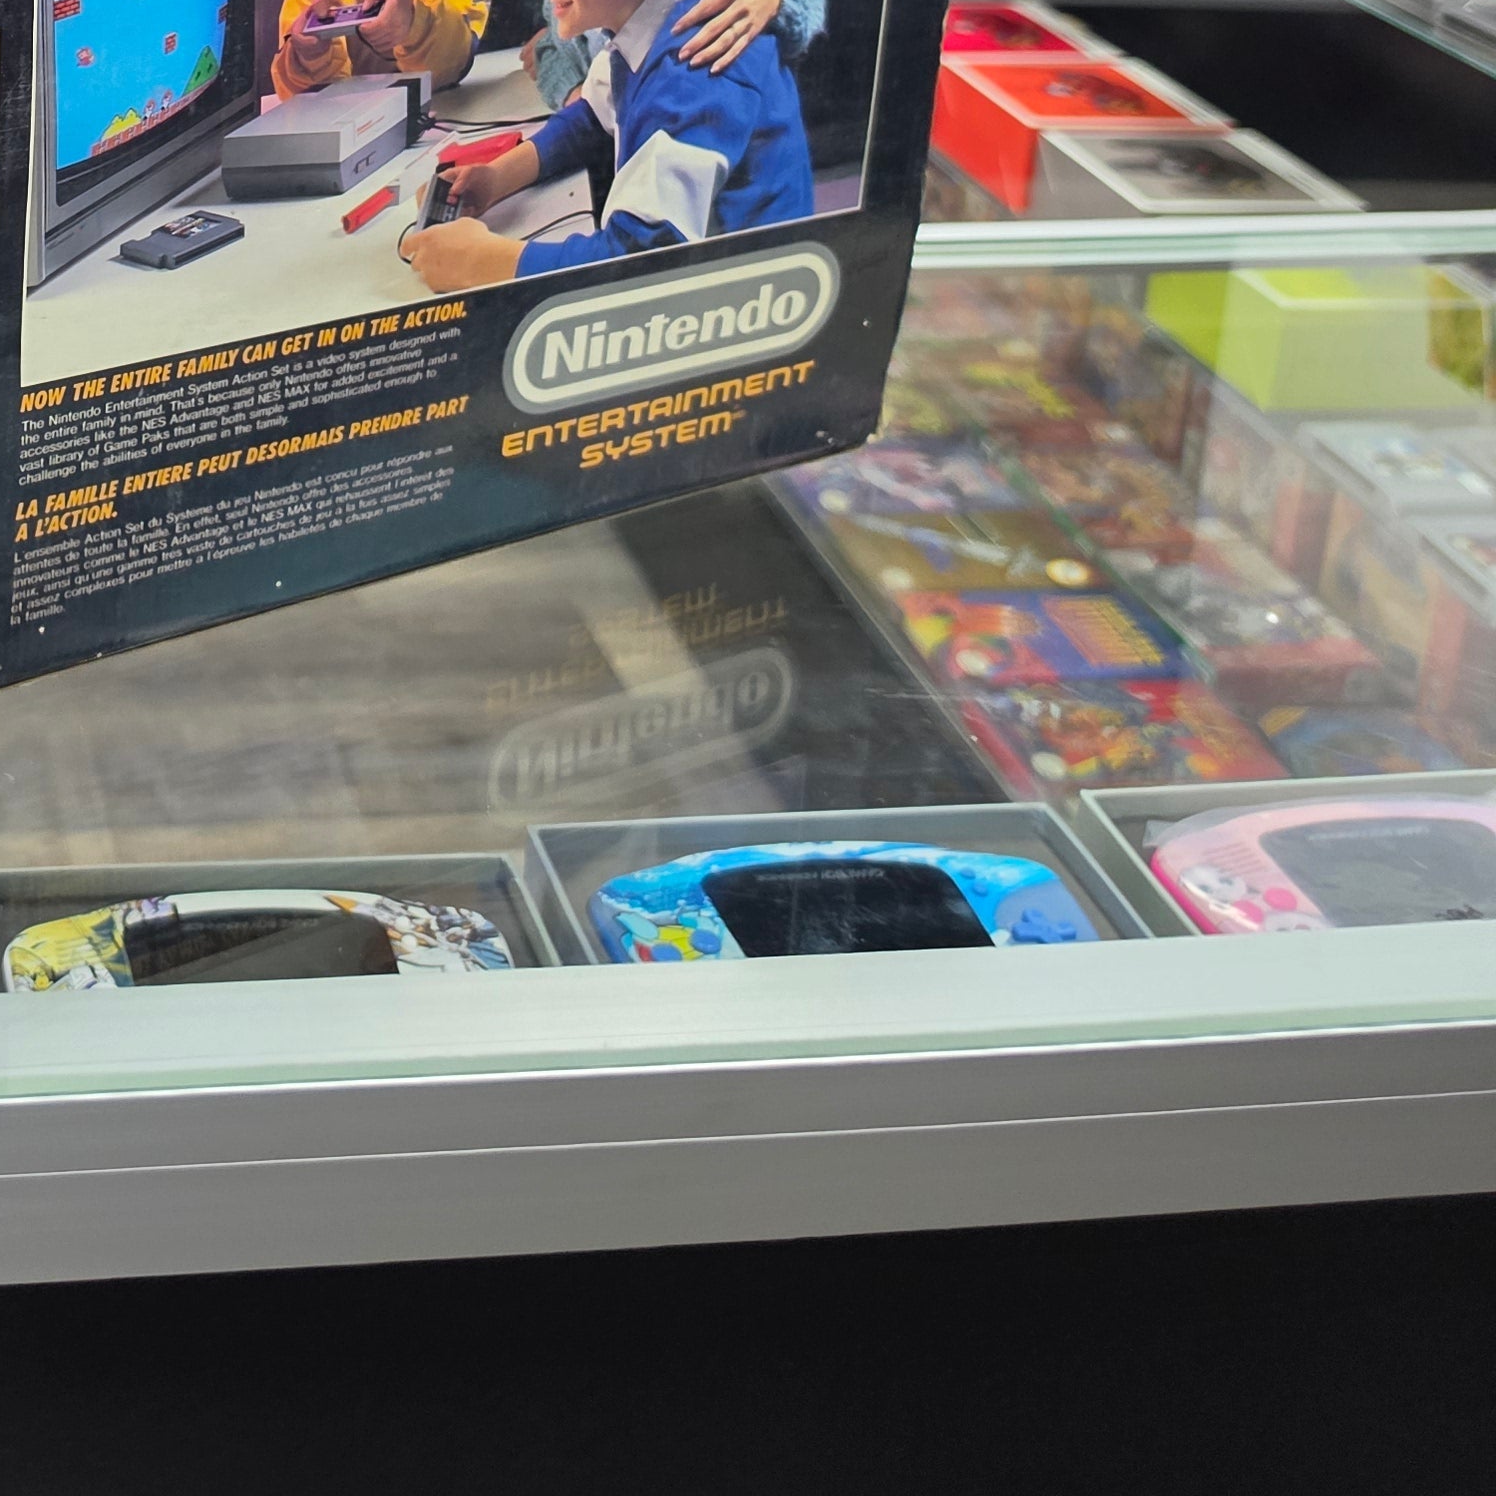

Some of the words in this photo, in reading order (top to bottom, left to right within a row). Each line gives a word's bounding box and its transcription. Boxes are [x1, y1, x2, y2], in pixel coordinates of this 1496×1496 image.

[19, 385, 66, 412] NOW
[73, 376, 106, 401] THE
[109, 362, 173, 393] ENTIRE
[176, 348, 239, 378] FAMILY
[241, 340, 277, 364] CAN
[280, 332, 314, 356] GET
[316, 327, 337, 347] IN
[340, 321, 365, 343] ON
[370, 314, 400, 336] THE
[402, 300, 467, 329] ACTION.
[542, 284, 806, 379] Nintendo
[501, 360, 815, 457] ENTERTAINMENT
[15, 498, 38, 521] LA
[44, 479, 119, 514] FAMILLE
[122, 461, 193, 495] ENTIERE
[196, 449, 242, 477] PEUT
[244, 425, 345, 465] DESORMAIS
[348, 406, 423, 439] PRENDRE
[425, 395, 469, 421] PART
[14, 522, 28, 542] A
[34, 500, 118, 537] L'ACTION.
